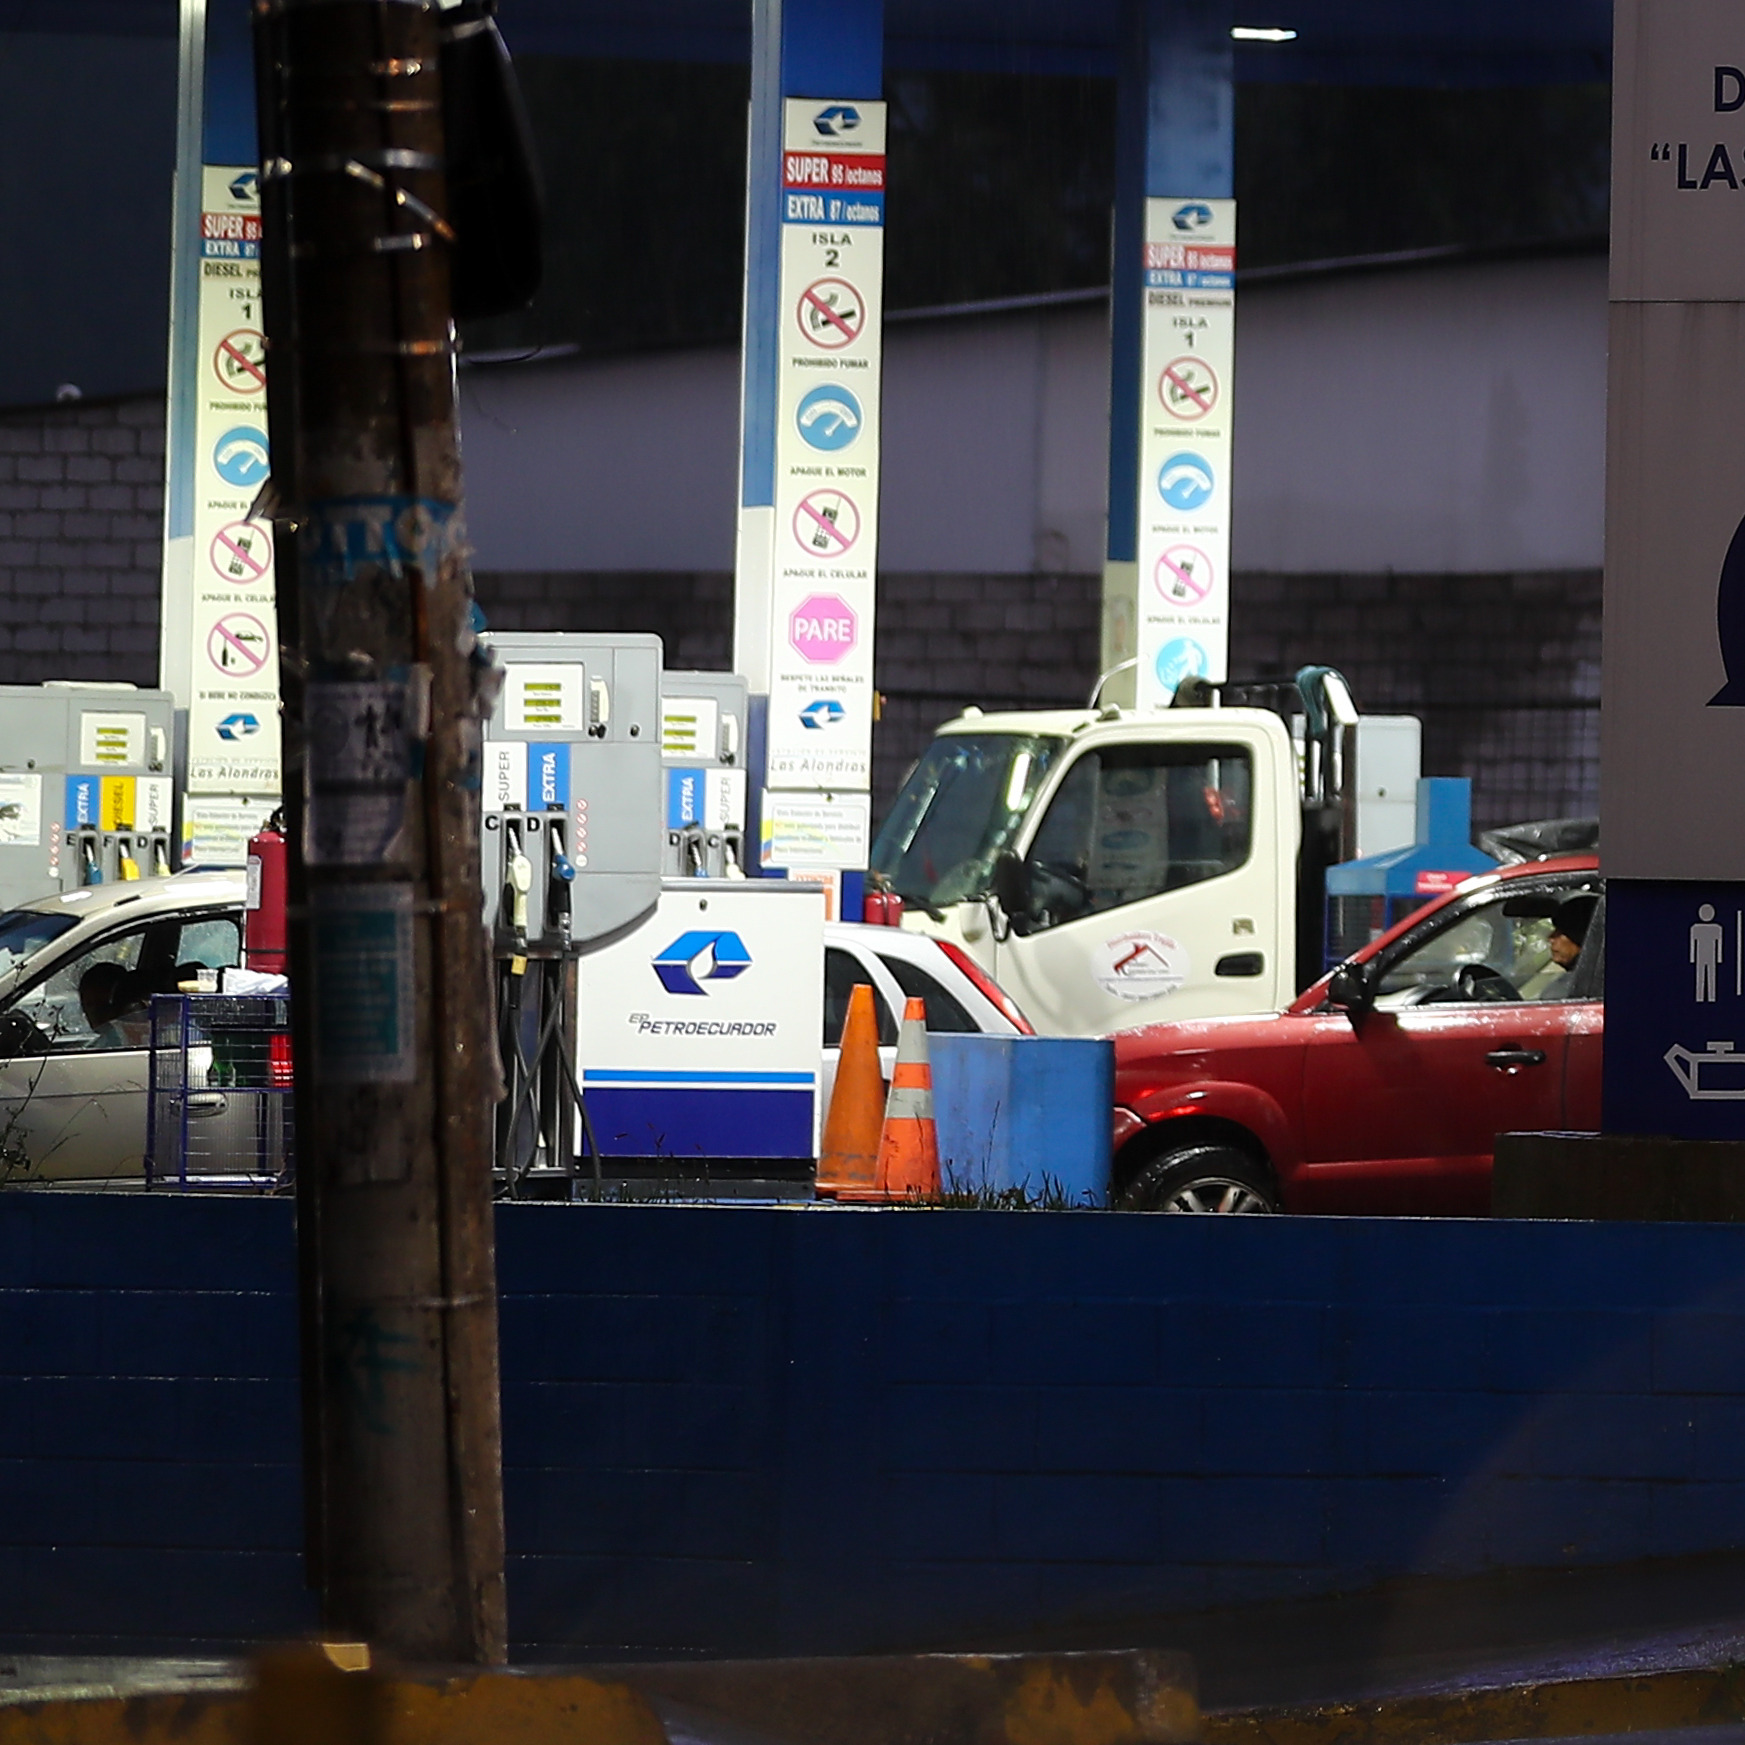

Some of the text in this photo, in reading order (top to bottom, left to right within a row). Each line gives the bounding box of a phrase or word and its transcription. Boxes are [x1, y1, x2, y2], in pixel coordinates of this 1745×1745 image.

[786, 156, 829, 183] SUPER
[788, 194, 825, 220] EXTRA
[204, 214, 243, 239] SUPER
[205, 239, 240, 256] EXTRA
[812, 233, 853, 246] ISLA
[825, 248, 840, 267] 2
[1147, 244, 1187, 268] SUPER
[204, 261, 243, 277] DIESEL
[242, 303, 252, 321] 1
[795, 617, 852, 642] PARE
[498, 750, 510, 802] SUPER
[542, 752, 556, 803] EXTRA
[770, 757, 867, 773] Las Alondras
[77, 781, 90, 823] EXTRA
[113, 780, 124, 827] DIESEL
[148, 783, 159, 824] SUPER
[682, 776, 694, 821] EXTRA
[720, 776, 732, 823] SUPER
[485, 815, 499, 831] C
[526, 816, 541, 832] D
[638, 1020, 777, 1037] PETROECUADOR
